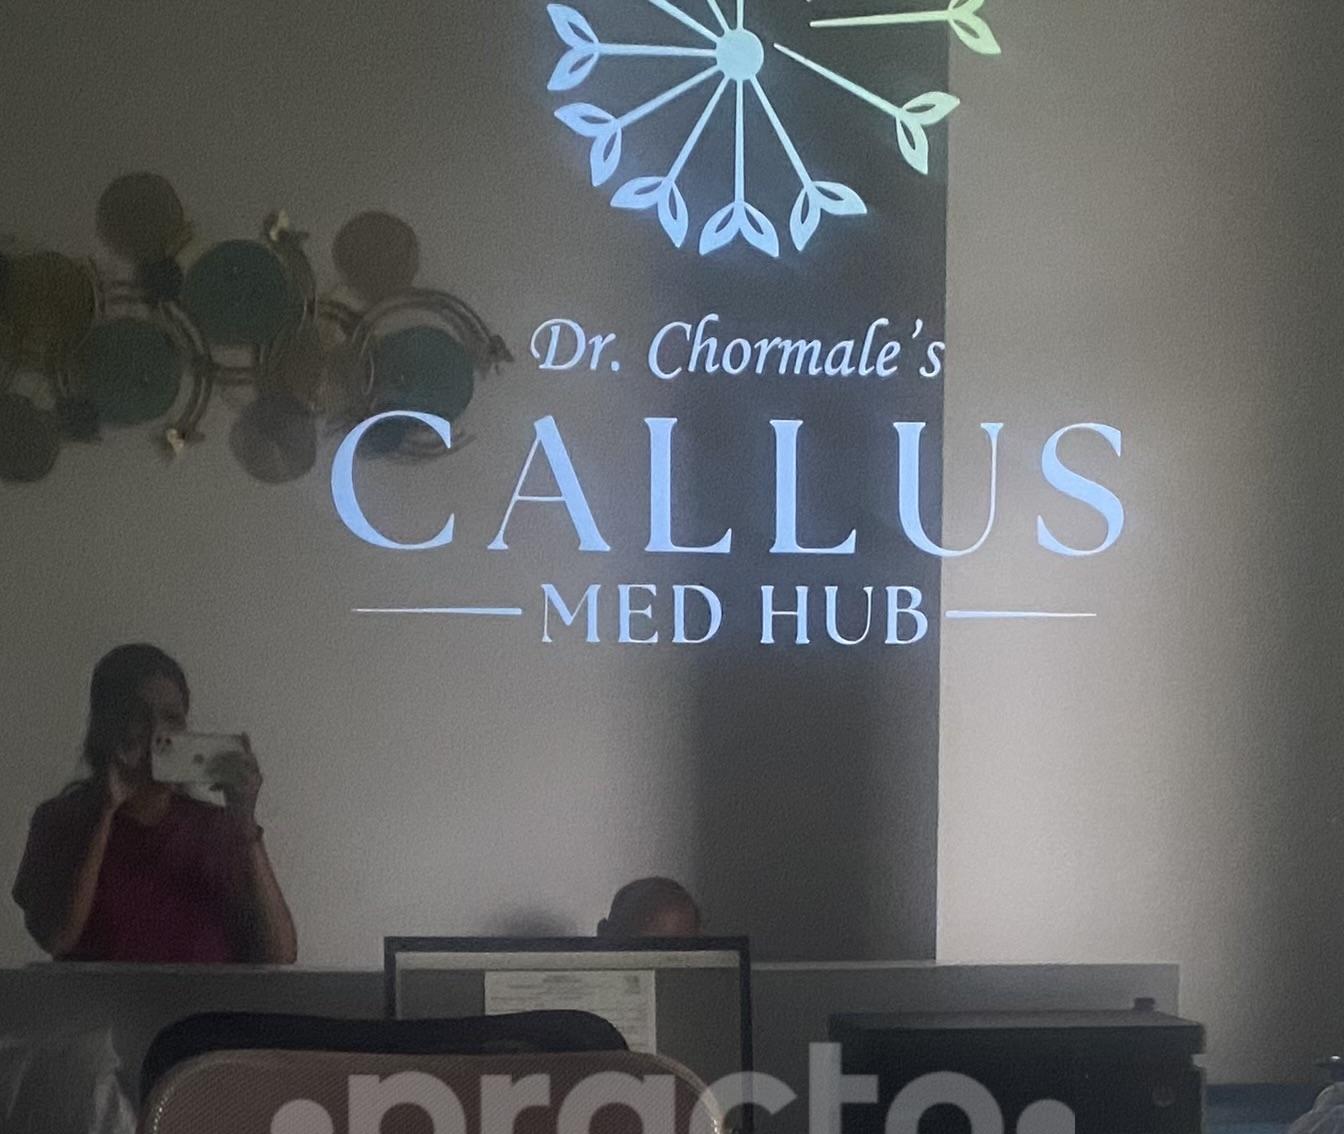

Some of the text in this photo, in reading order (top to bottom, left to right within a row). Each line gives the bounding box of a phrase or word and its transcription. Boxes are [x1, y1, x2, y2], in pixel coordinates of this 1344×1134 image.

[529, 313, 947, 380] Dr. Chormale's
[329, 409, 1128, 557] CALLUS
[541, 583, 930, 646] MED HUB
